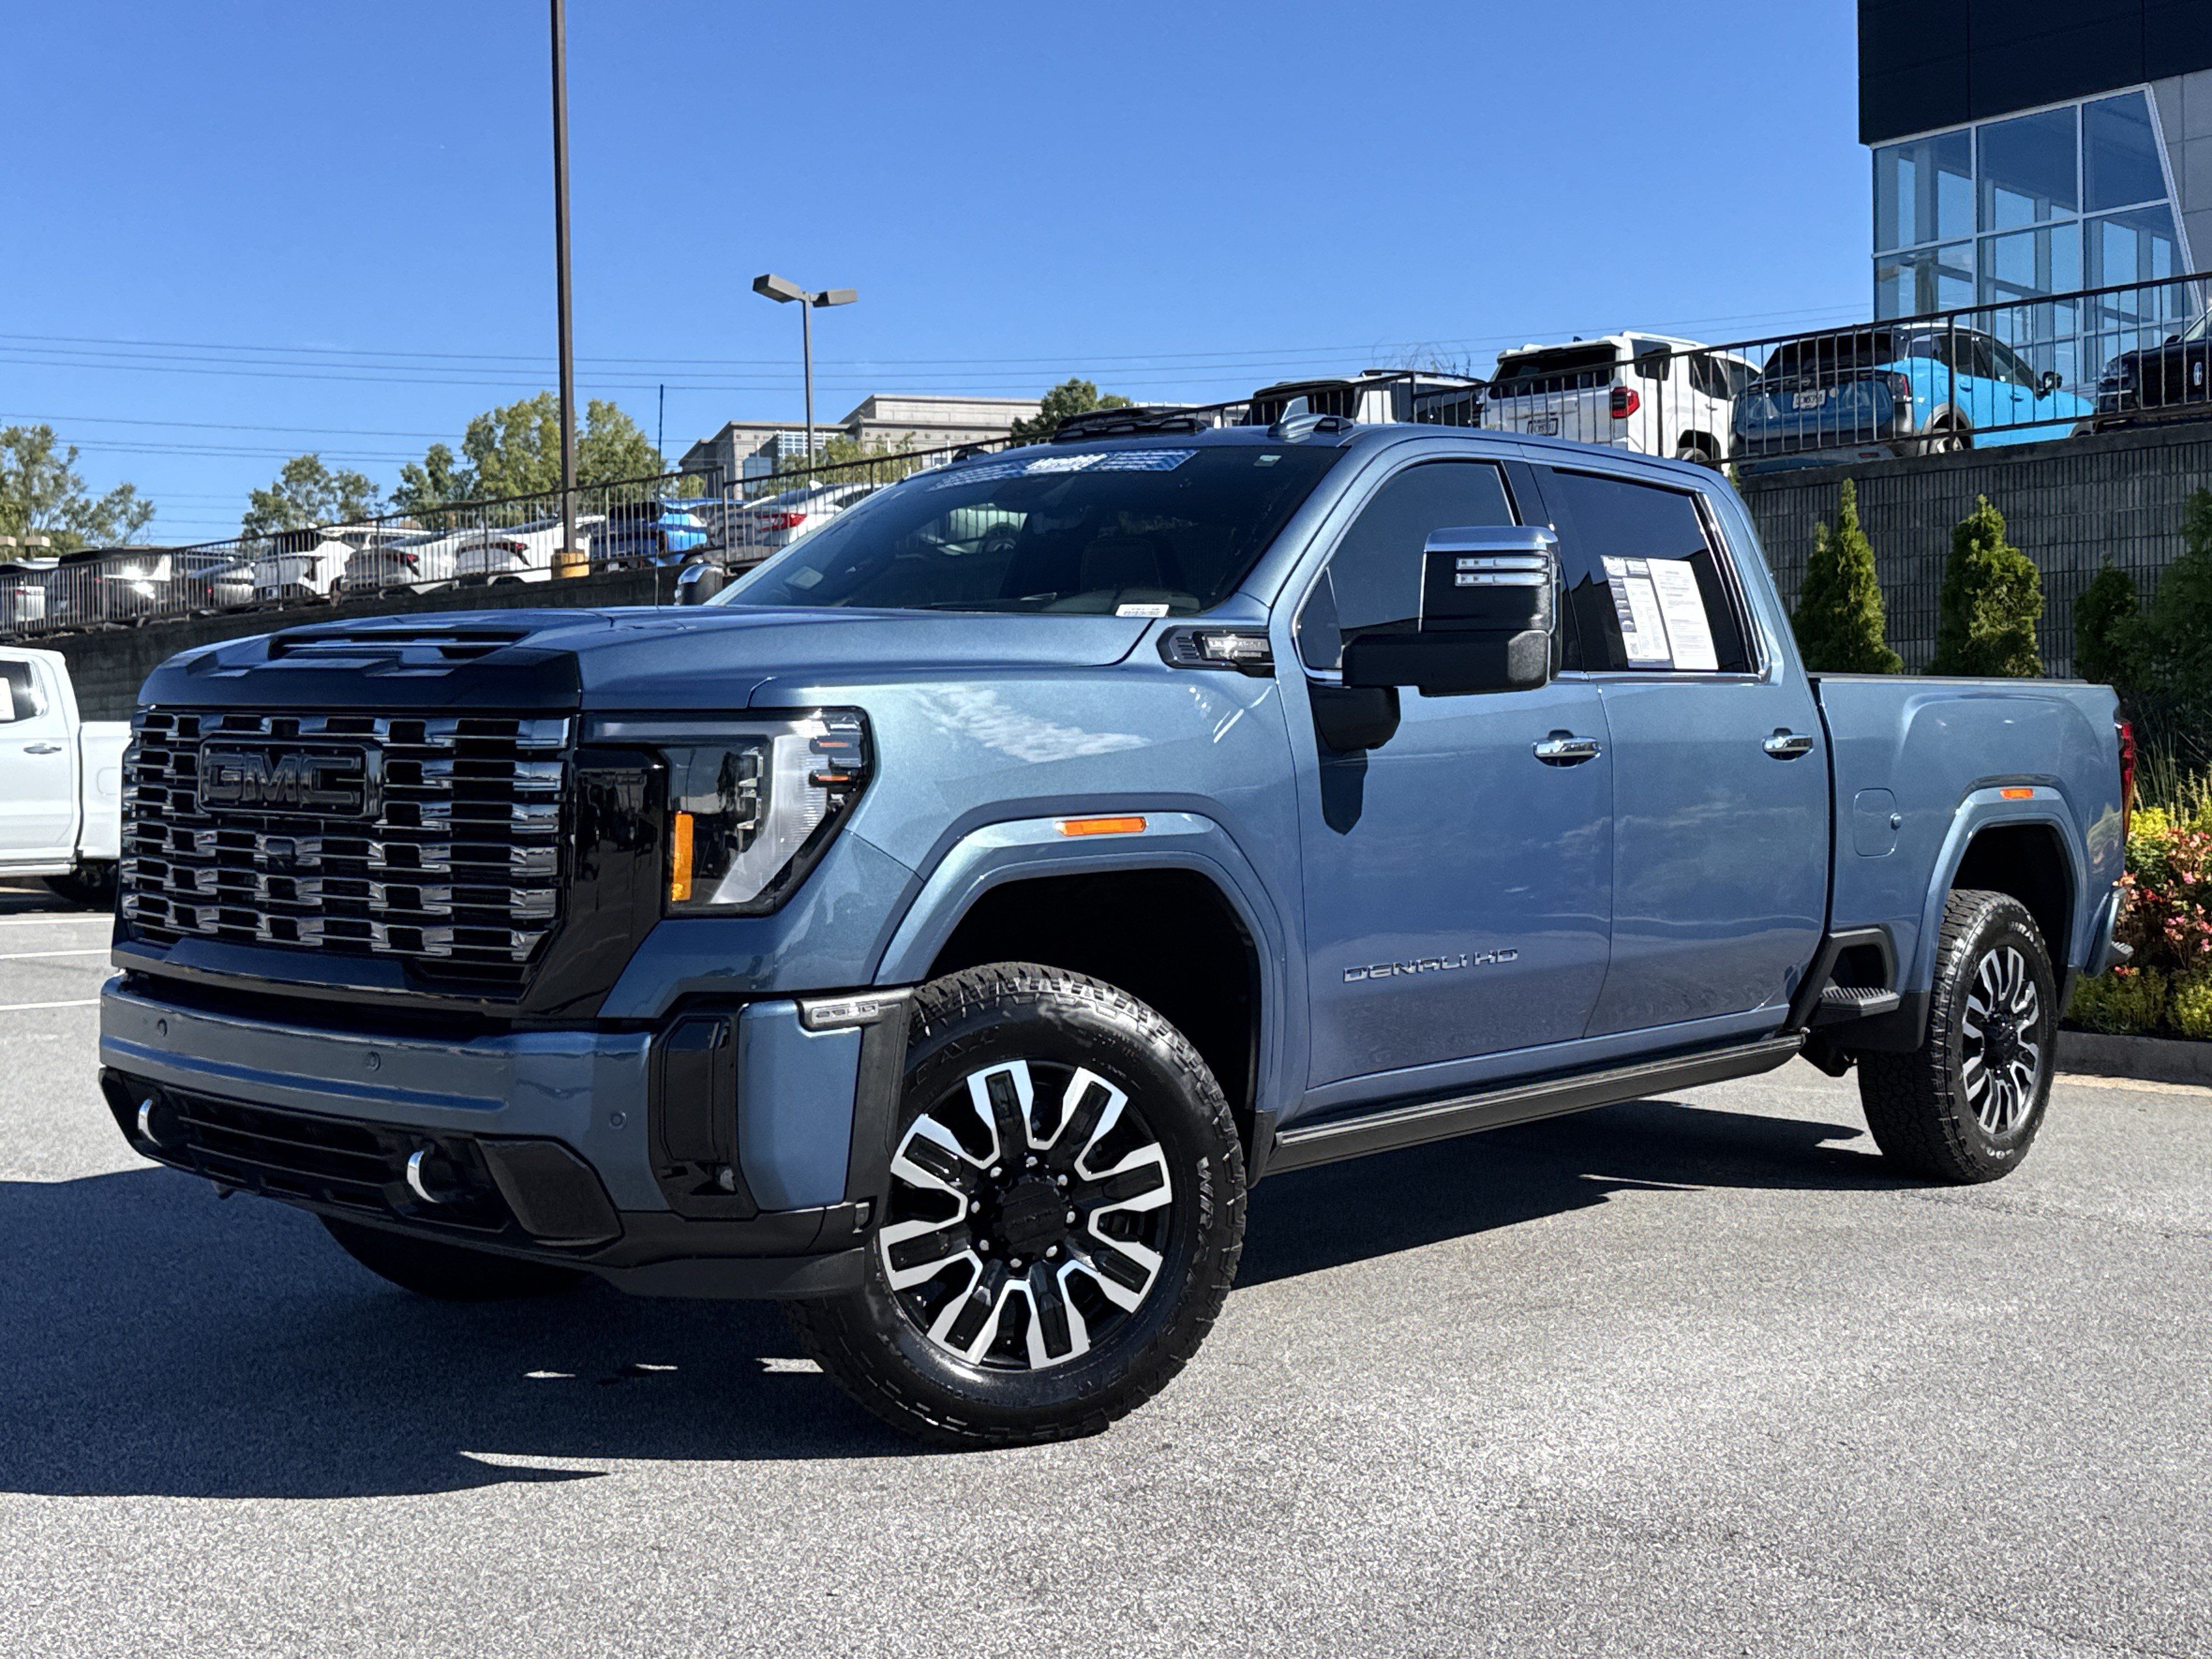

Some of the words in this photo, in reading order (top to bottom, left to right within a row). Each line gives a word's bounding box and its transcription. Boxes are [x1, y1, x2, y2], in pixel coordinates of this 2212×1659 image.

[203, 752, 362, 804] GMC
[1343, 954, 1468, 983] DENALI
[1474, 949, 1518, 967] HD
